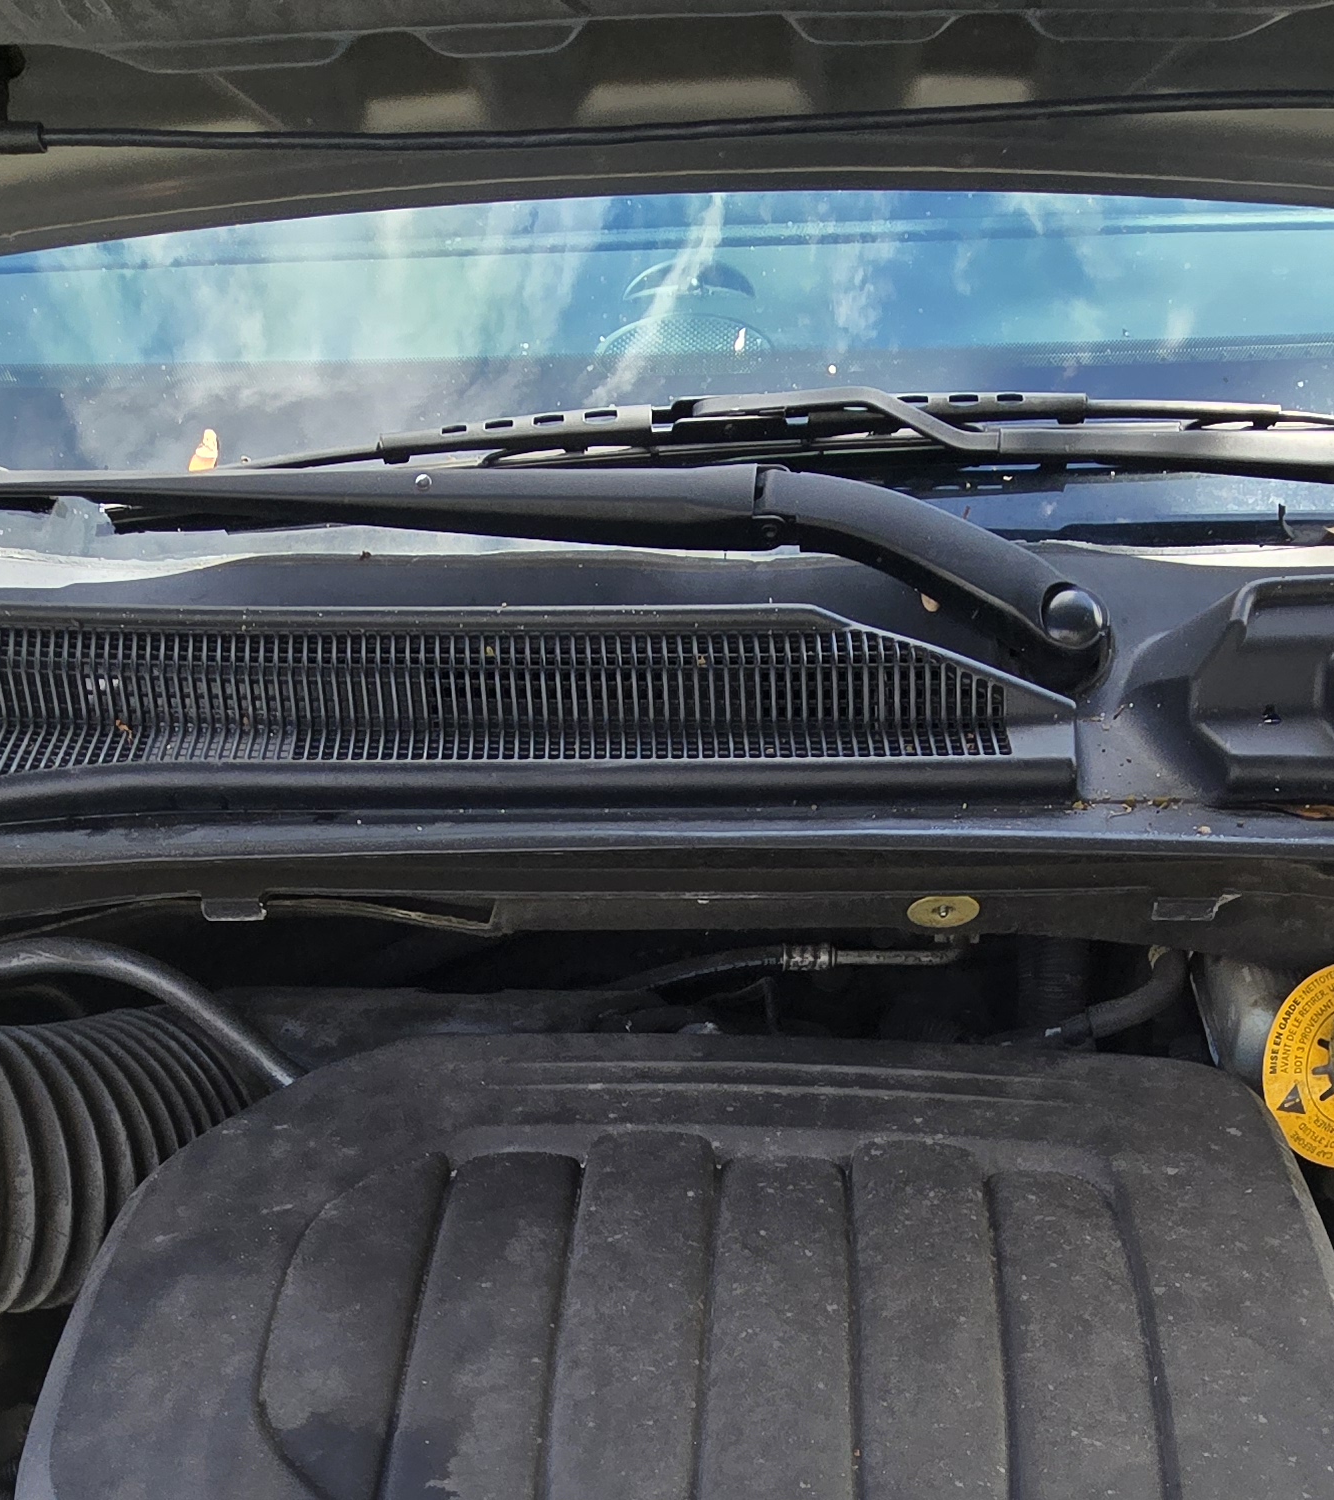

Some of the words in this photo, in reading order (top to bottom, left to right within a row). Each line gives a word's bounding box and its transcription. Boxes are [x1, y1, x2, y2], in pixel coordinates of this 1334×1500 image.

[1279, 998, 1300, 1030] GARDE
[1273, 1032, 1283, 1047] EN
[1280, 1043, 1292, 1074] AVANT
[1287, 1027, 1297, 1042] DE
[1292, 1016, 1303, 1029] LE
[1294, 1055, 1304, 1074] DOT
[1299, 999, 1334, 1045] PROVENANT
[1269, 1048, 1279, 1074] MISE
[1290, 1131, 1317, 1154] BEFORE
[1316, 1150, 1334, 1161] CAP
